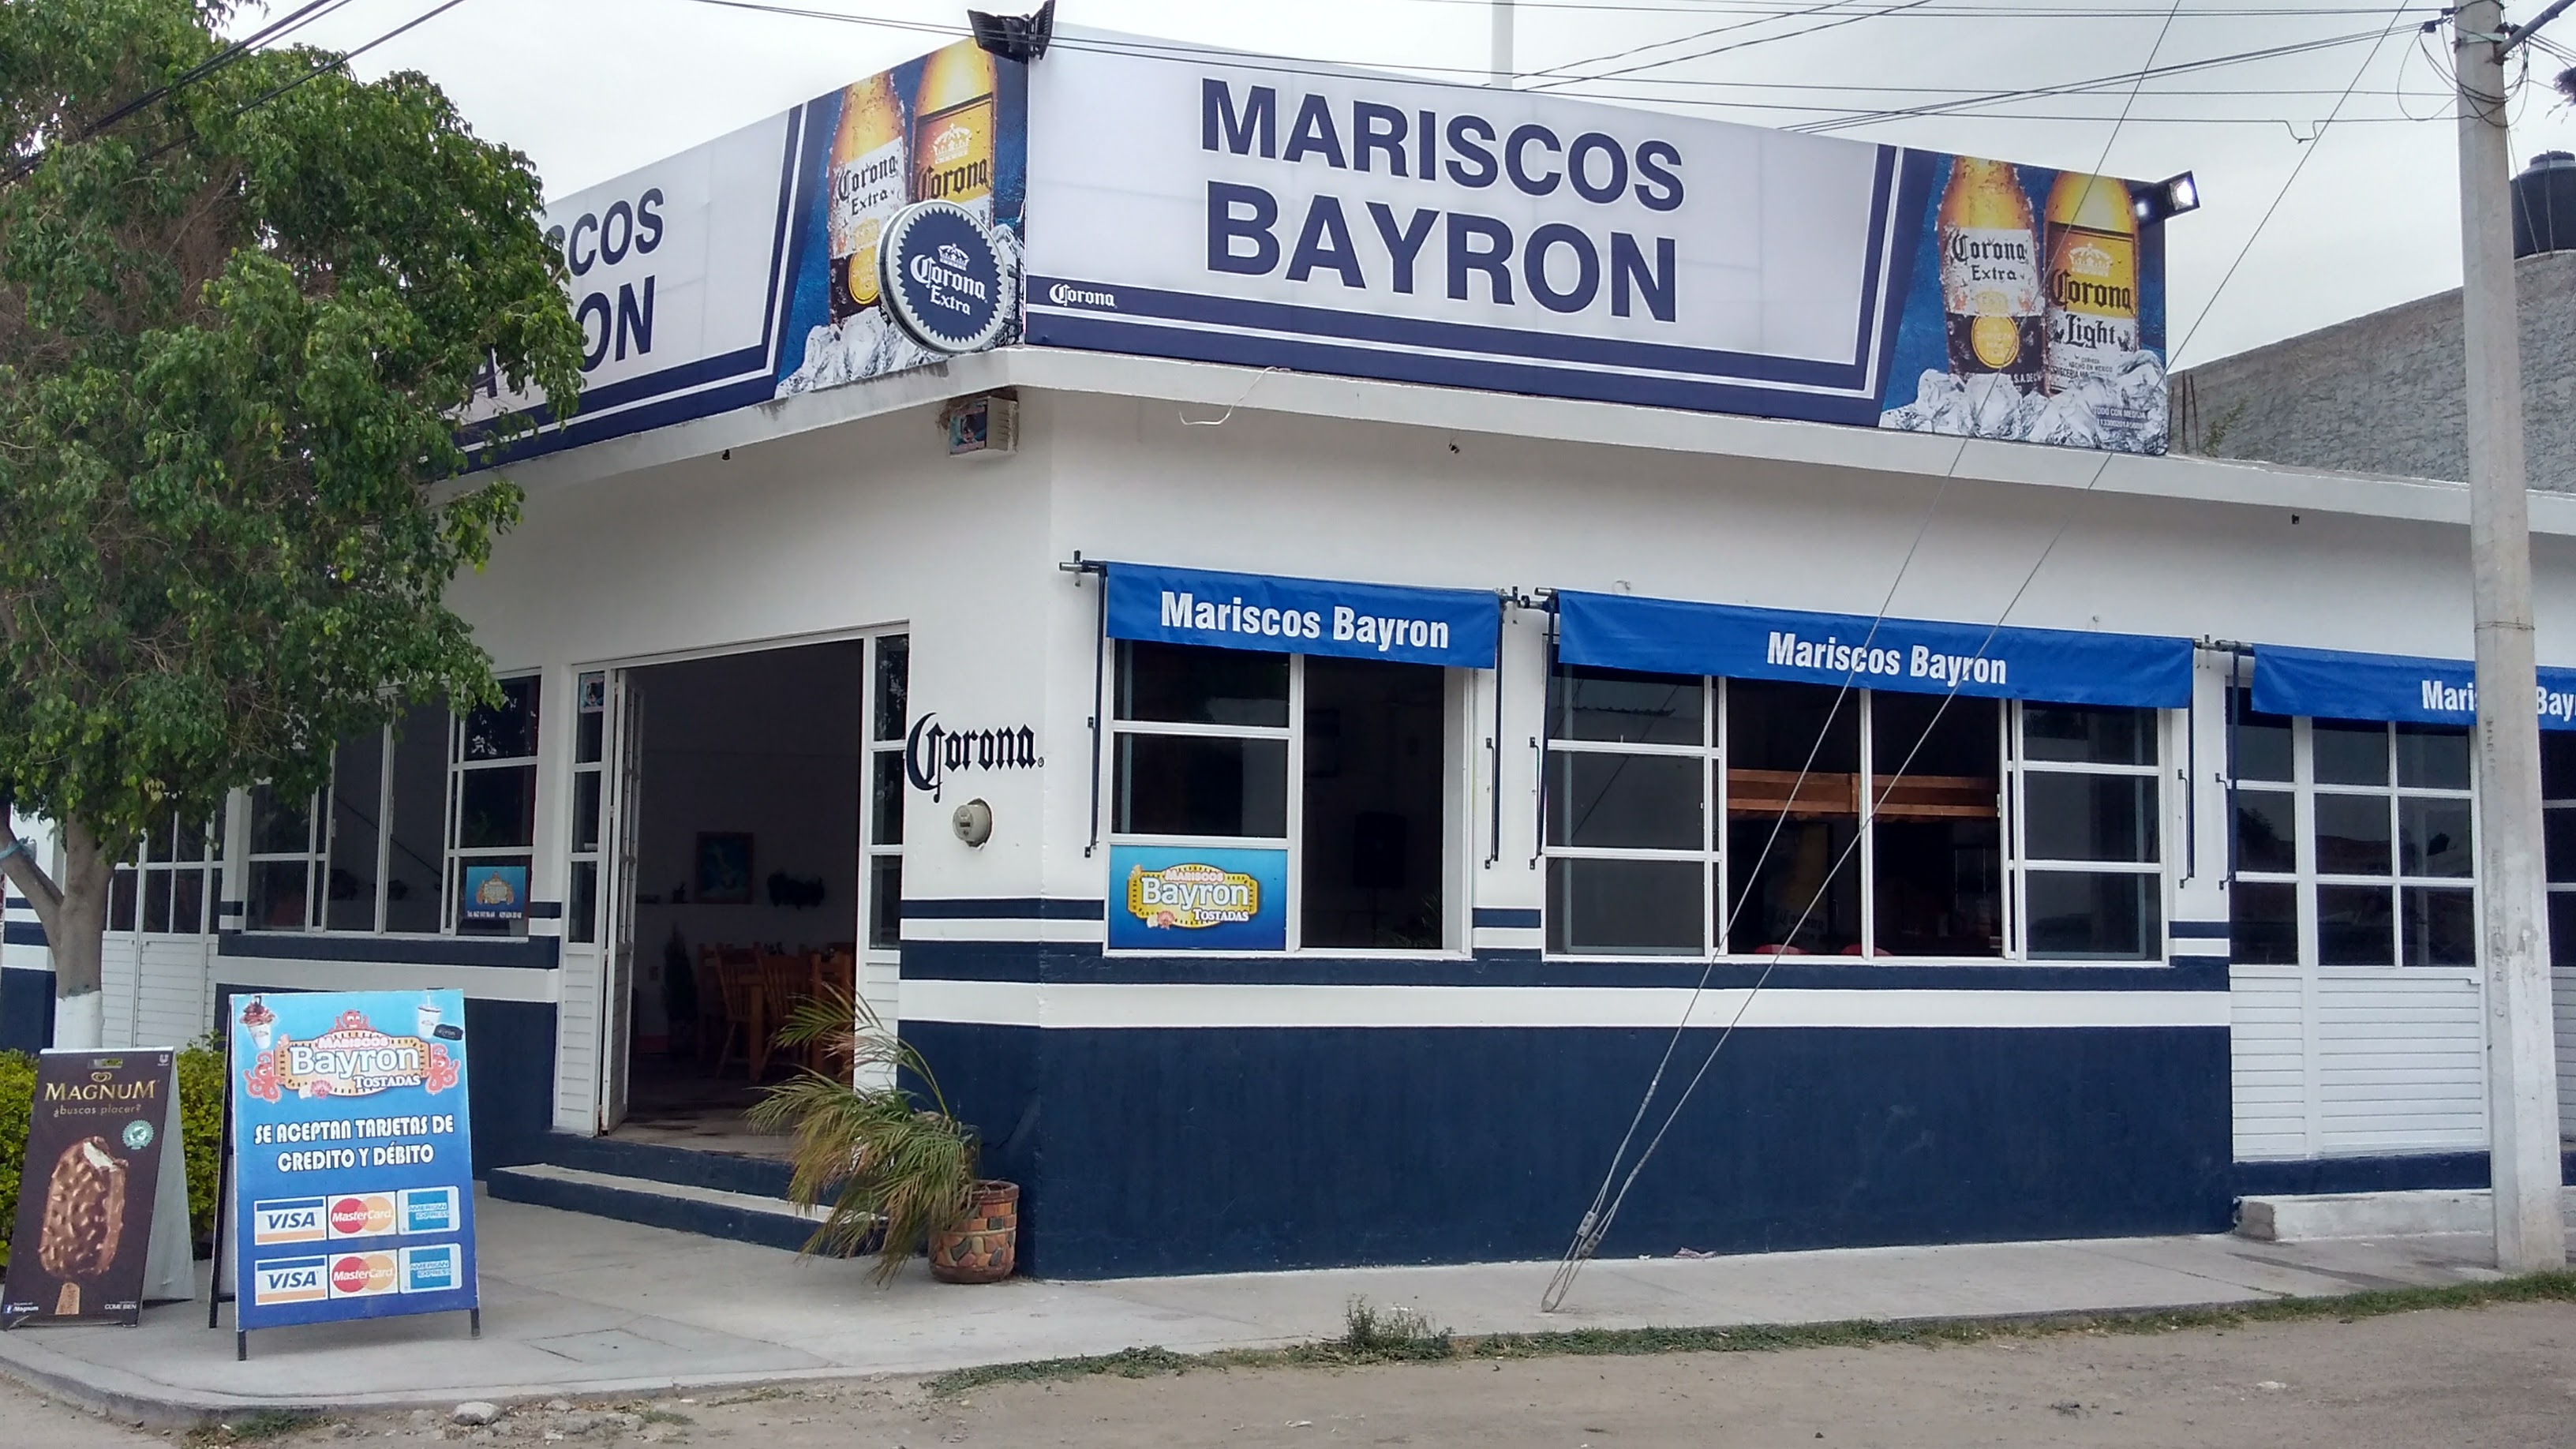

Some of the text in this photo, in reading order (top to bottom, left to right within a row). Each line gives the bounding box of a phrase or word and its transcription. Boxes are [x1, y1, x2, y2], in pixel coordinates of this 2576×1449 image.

[1202, 77, 1685, 213] MARISCOS
[837, 155, 897, 201] Corona
[918, 159, 990, 201] Corona
[851, 188, 888, 215] Extra
[1207, 181, 1677, 323] BAYRON
[1952, 232, 2026, 264] Corona
[910, 254, 987, 301] Corona
[1971, 264, 2017, 282] Extra
[930, 284, 971, 315] Extra
[1049, 283, 1115, 307] Corona
[2053, 269, 2133, 311] Corona
[2065, 314, 2116, 349] Light
[1160, 590, 1449, 653] Mariscos Bayron
[1766, 631, 2007, 688] Mariscos Bayron
[2422, 680, 2576, 721] Mari Bay
[906, 712, 1036, 802] Corona
[1164, 869, 1225, 882] MARISCOS
[1141, 877, 1249, 911] Bayron
[1193, 908, 1249, 922] TOSTADAS
[316, 1037, 390, 1050] MARISCOS
[290, 1044, 421, 1079] Bayron
[44, 1080, 156, 1101] MAGNUM
[353, 1075, 421, 1088] TOSTADAS
[254, 1115, 454, 1144] SE ACEPTAN TARJETAS DE
[277, 1141, 434, 1172] CREDITO Y DÉBITO
[268, 1211, 316, 1230] VISA
[331, 1208, 394, 1222] MasterCard
[268, 1271, 317, 1290] VISA
[333, 1267, 394, 1282] MasterCard
